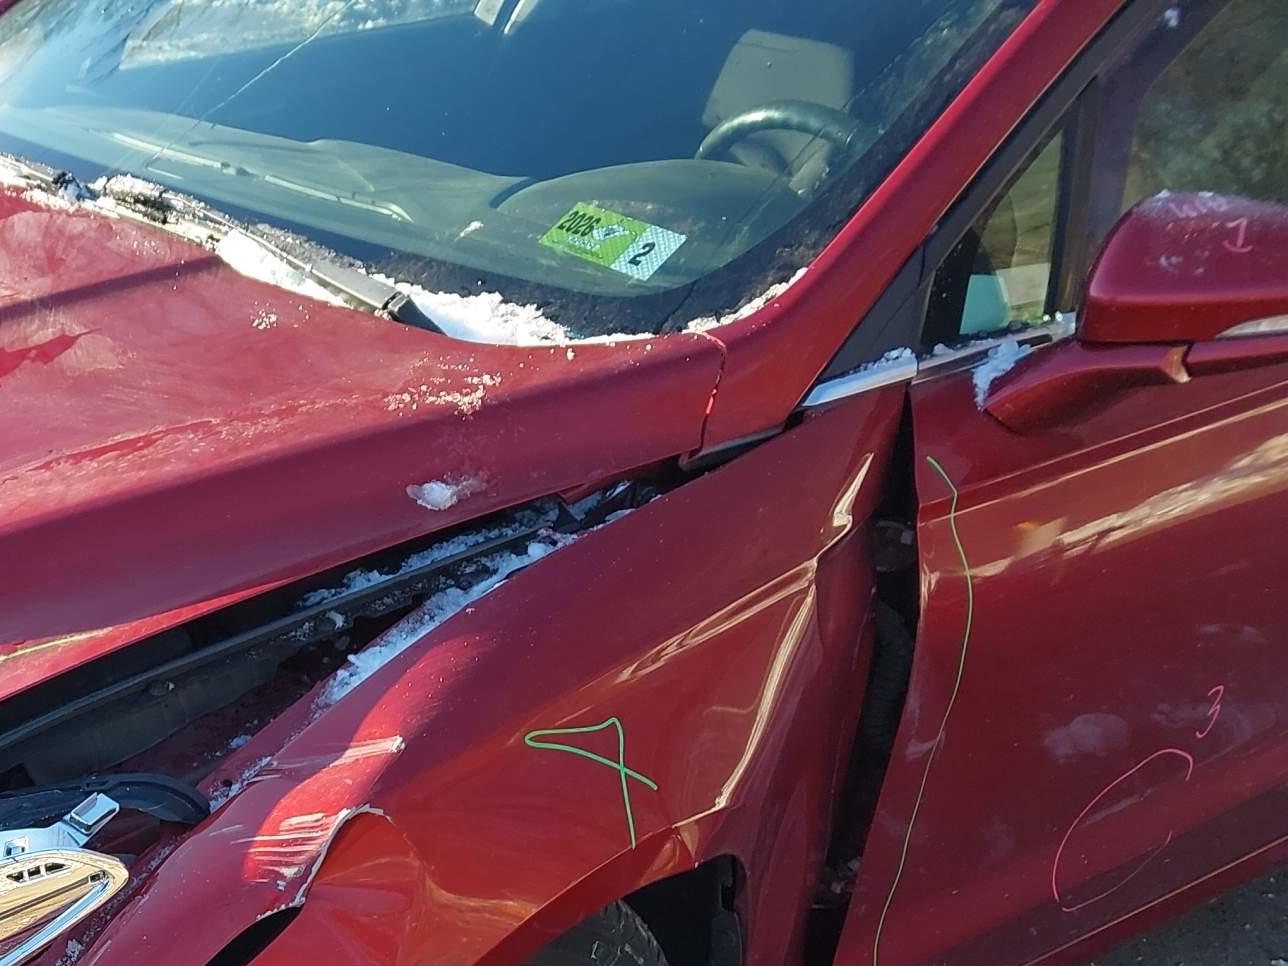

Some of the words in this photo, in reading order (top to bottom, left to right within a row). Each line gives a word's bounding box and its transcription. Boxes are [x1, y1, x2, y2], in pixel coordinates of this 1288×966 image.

[557, 210, 602, 238] 2026
[1223, 216, 1254, 253] 1
[628, 241, 656, 267] 2
[1195, 684, 1225, 738] 3
